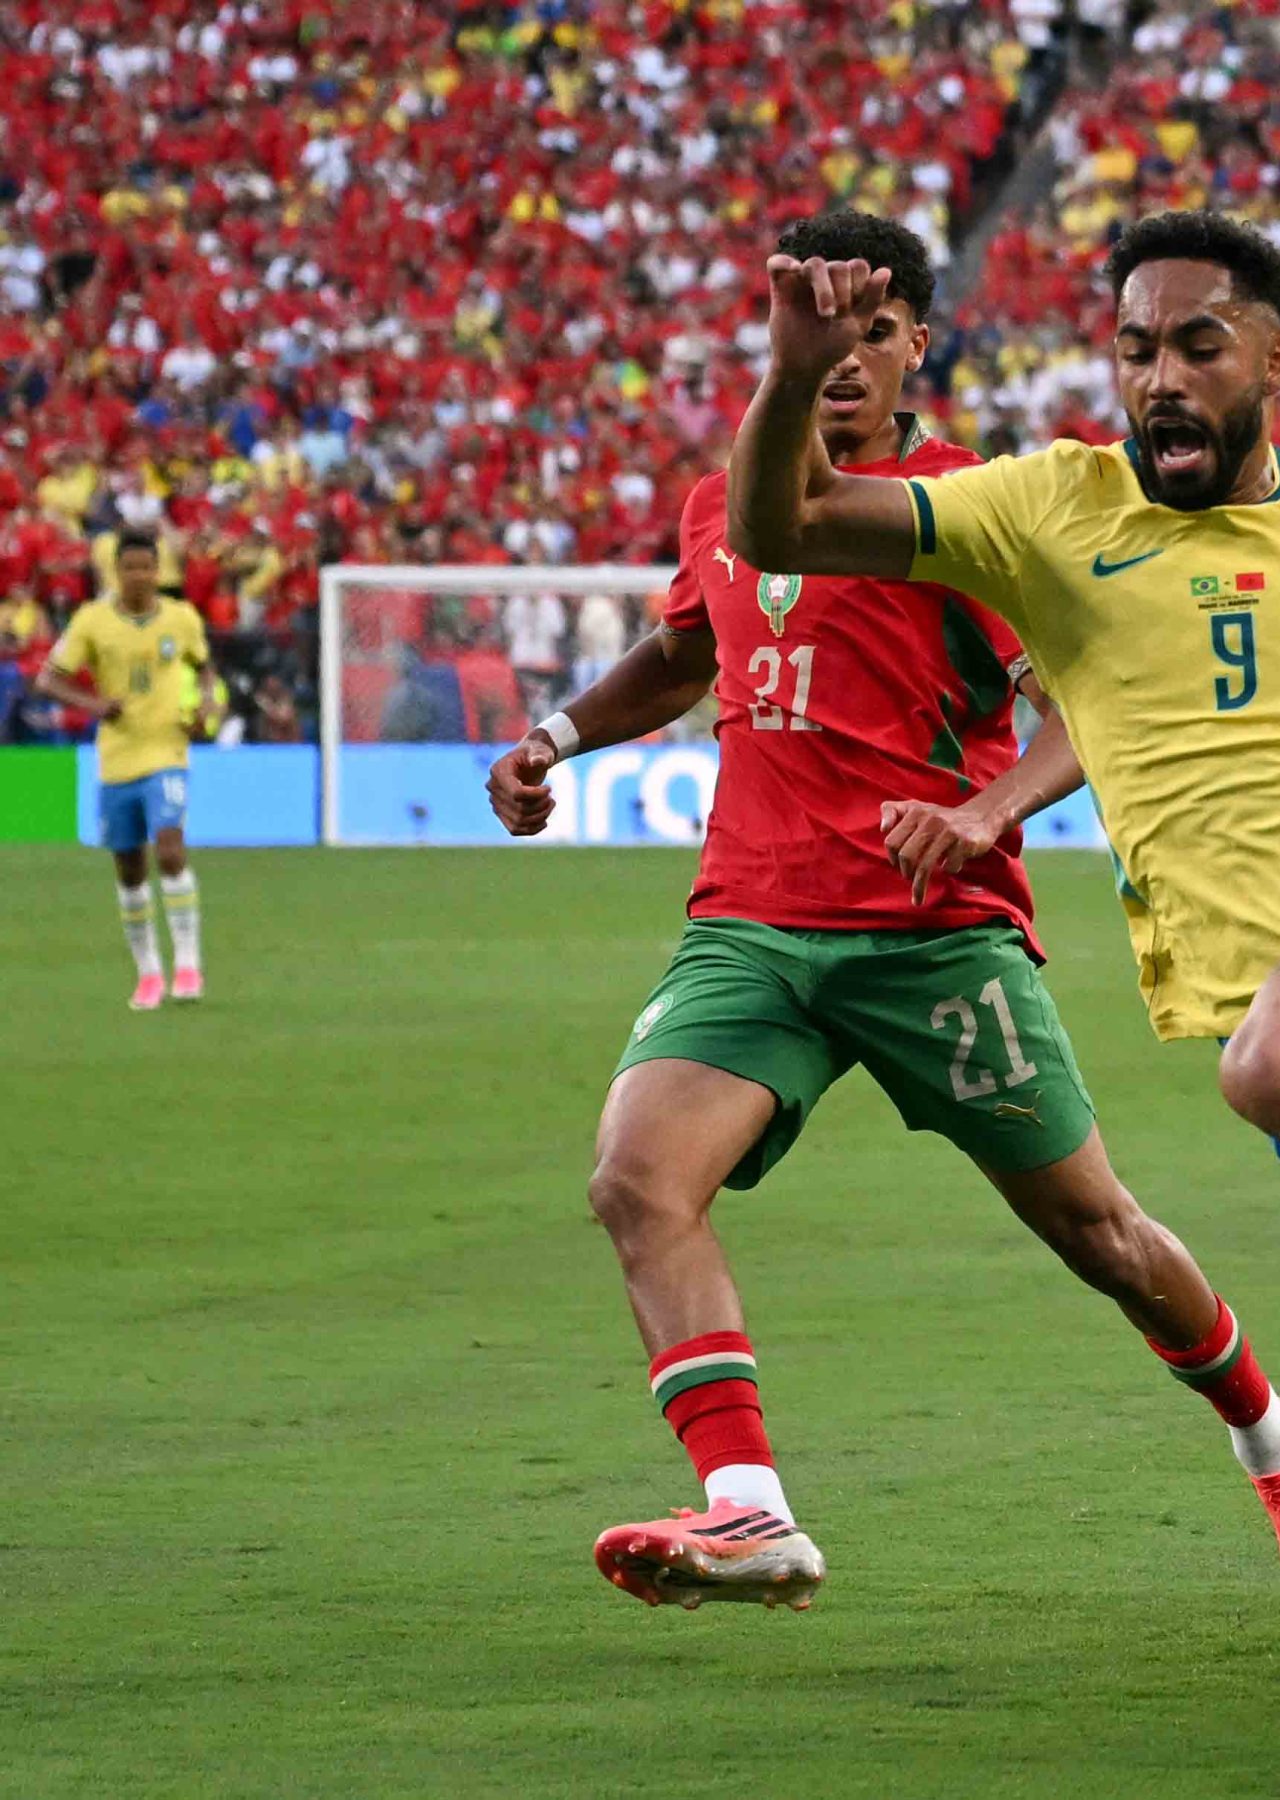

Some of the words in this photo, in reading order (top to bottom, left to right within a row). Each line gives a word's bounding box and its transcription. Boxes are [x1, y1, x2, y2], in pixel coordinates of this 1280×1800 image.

[747, 645, 822, 731] 21
[1210, 611, 1258, 711] 9
[930, 976, 1038, 1102] 21
